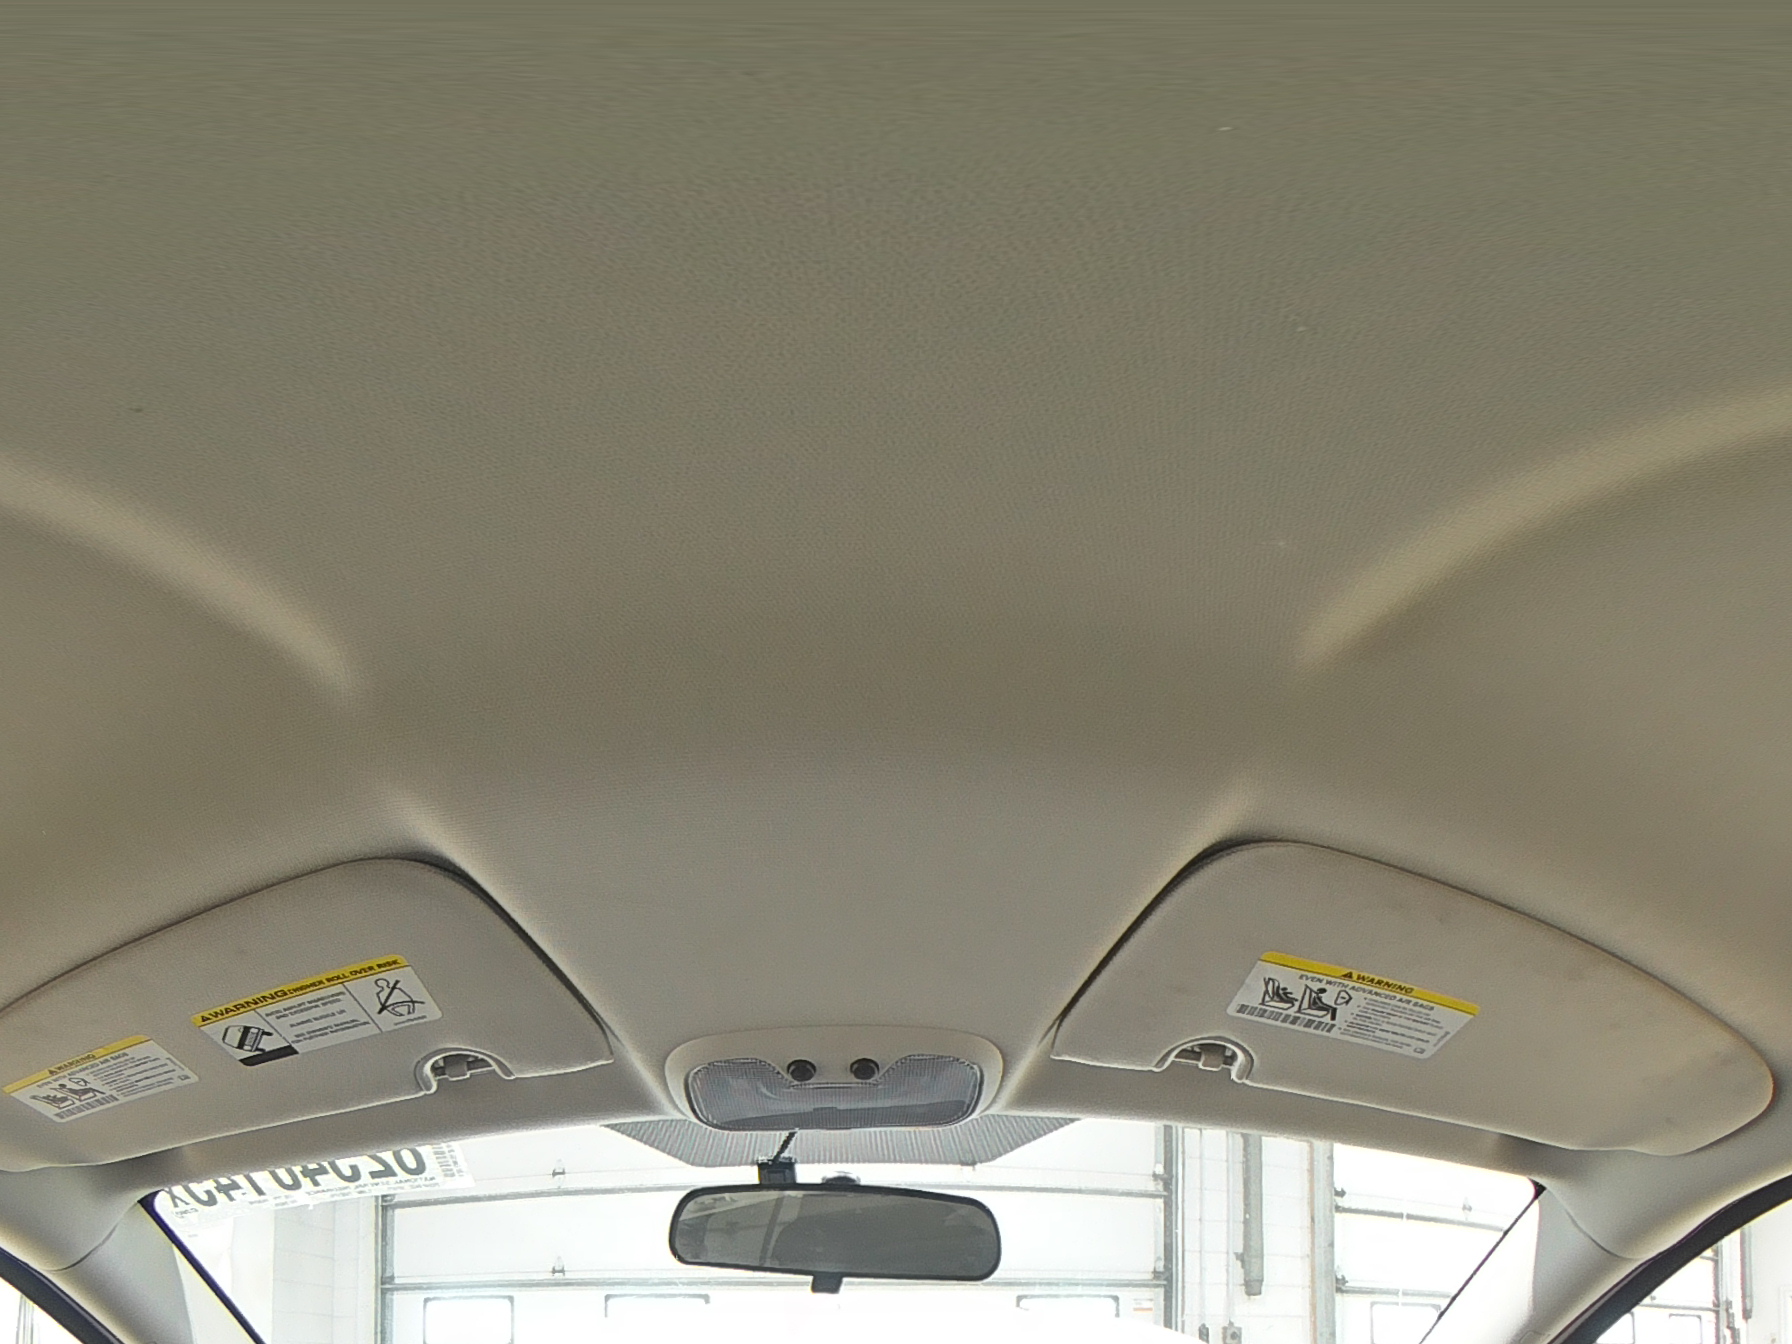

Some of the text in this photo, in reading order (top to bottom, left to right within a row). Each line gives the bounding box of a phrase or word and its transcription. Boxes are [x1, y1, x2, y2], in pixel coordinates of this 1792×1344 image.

[325, 973, 349, 983] ROLL
[349, 965, 375, 976] OVER
[376, 959, 400, 969] RISK
[1298, 974, 1325, 984] EVEN
[1325, 978, 1348, 989] WITH
[1349, 985, 1396, 1001] ADVANCED
[1397, 997, 1412, 1005] AIR
[1356, 973, 1415, 994] WARNING
[56, 1053, 96, 1072] WARNING
